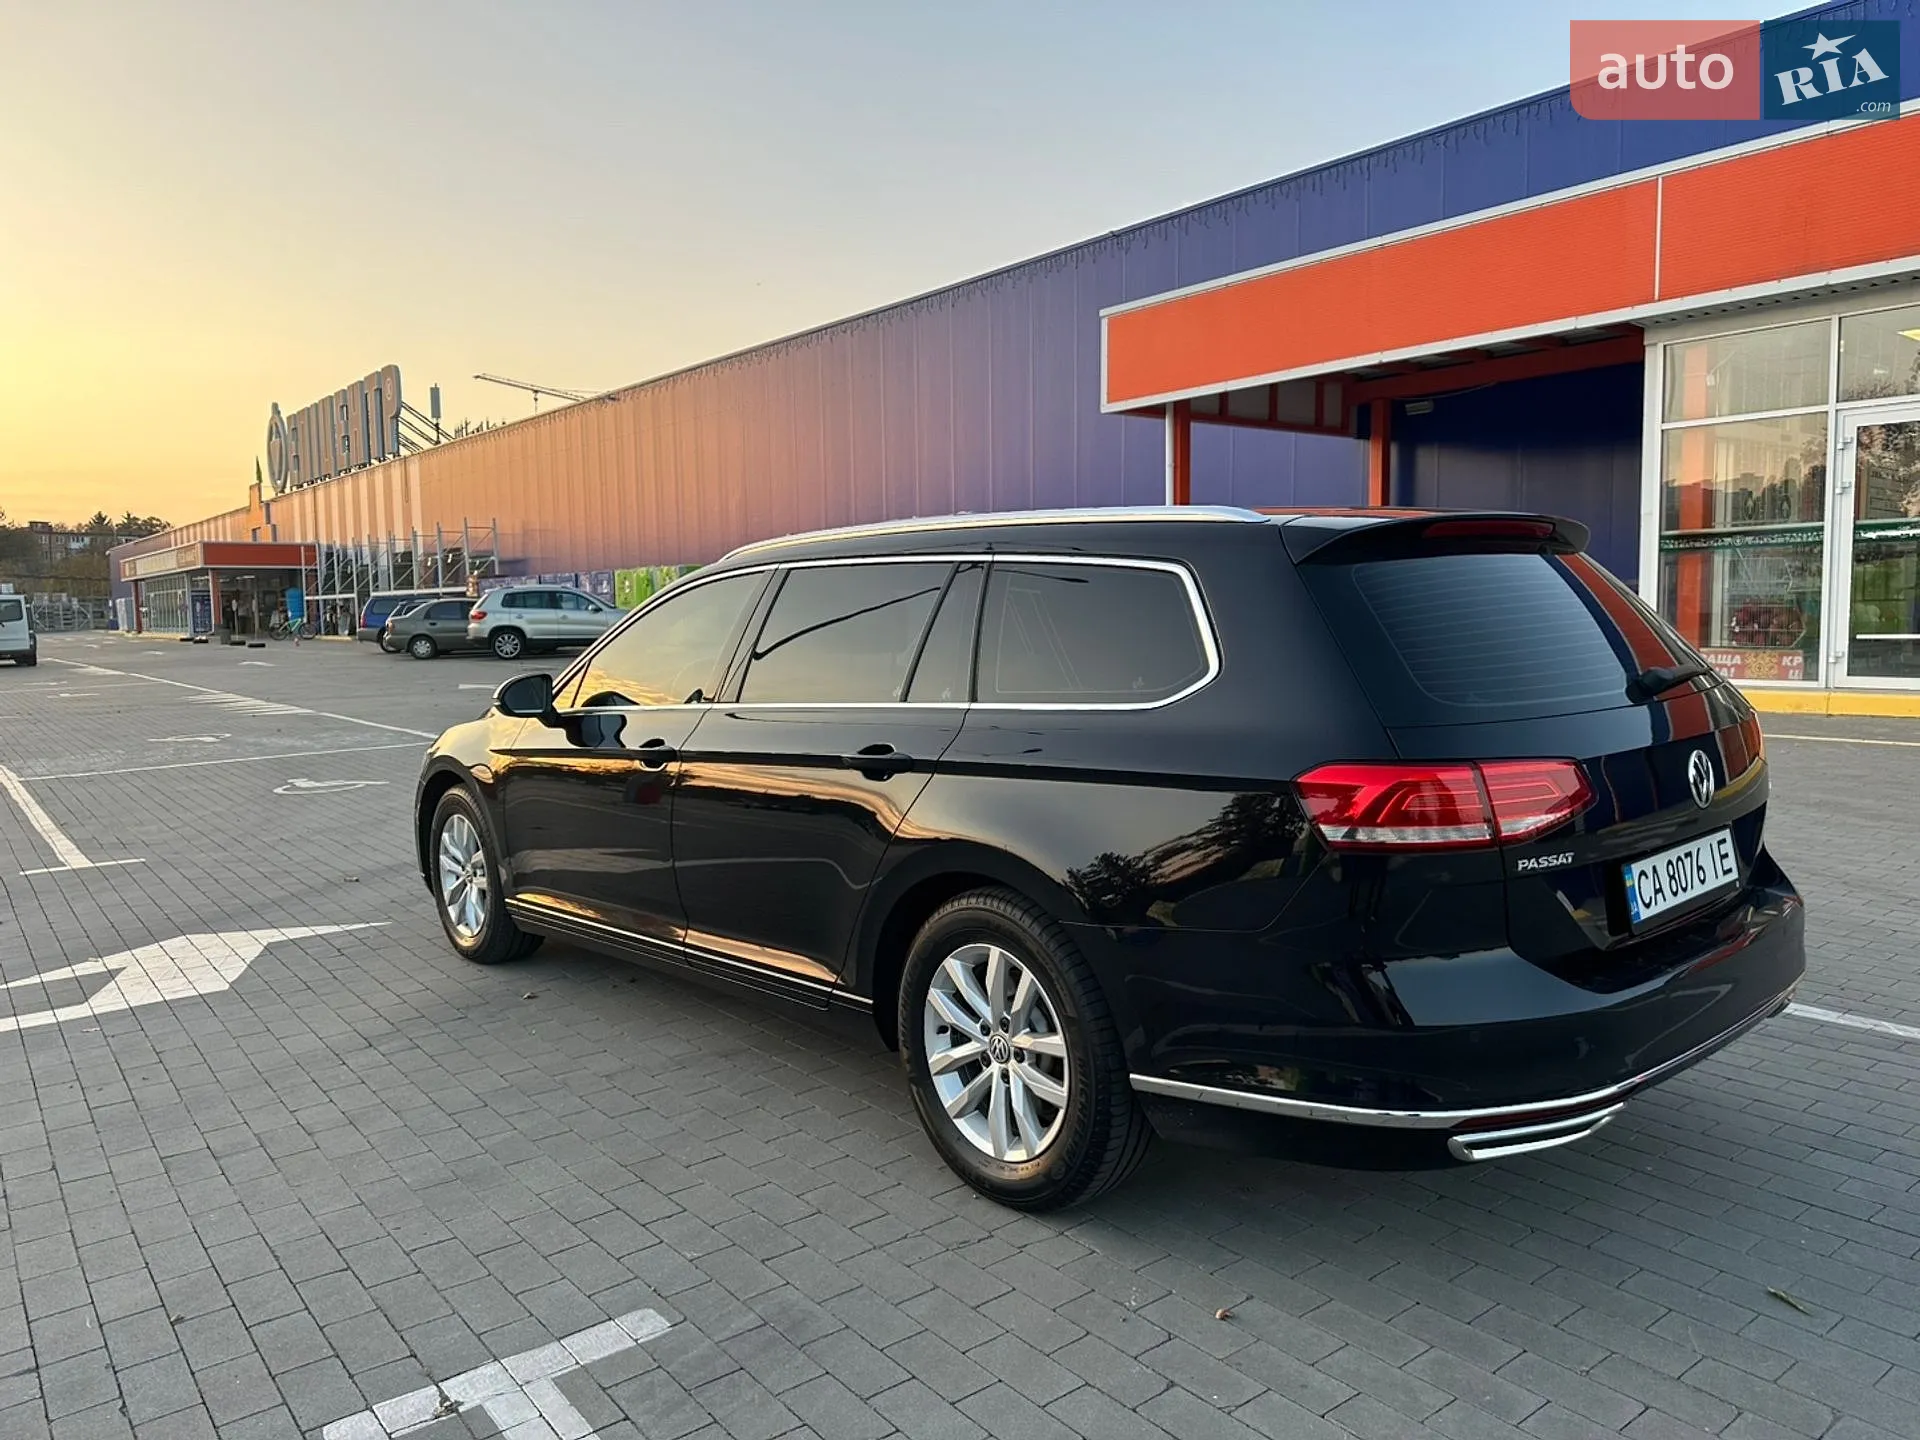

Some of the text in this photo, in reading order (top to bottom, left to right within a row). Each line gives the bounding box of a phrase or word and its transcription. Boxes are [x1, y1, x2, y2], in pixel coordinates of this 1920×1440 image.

[1517, 852, 1575, 871] PASSAT
[1637, 838, 1733, 909] CA 8076 IE
